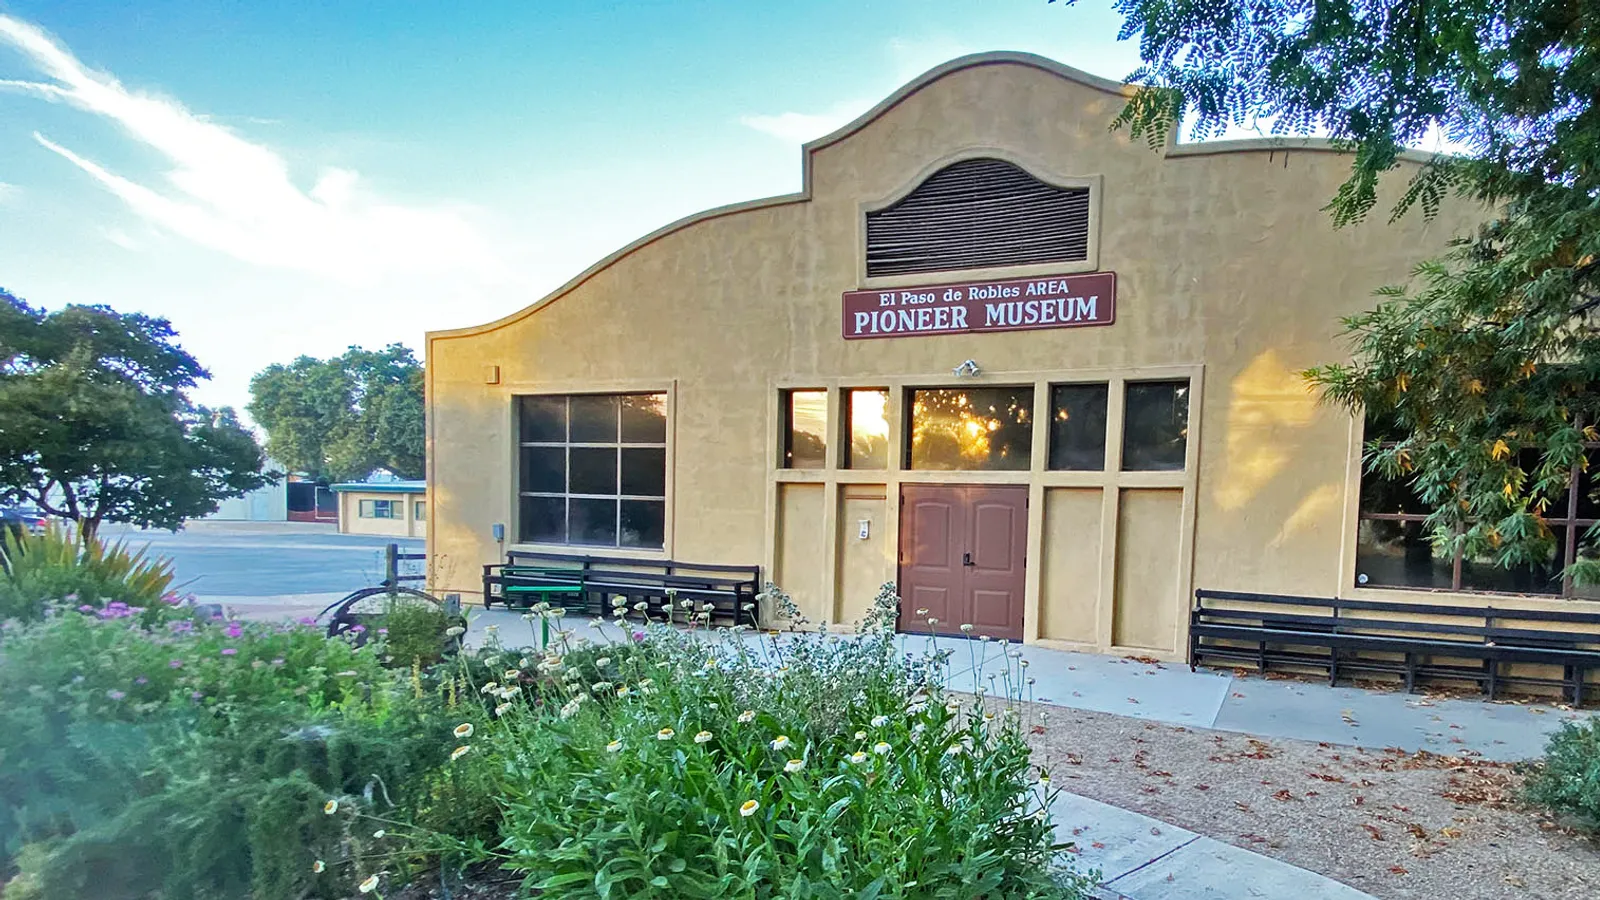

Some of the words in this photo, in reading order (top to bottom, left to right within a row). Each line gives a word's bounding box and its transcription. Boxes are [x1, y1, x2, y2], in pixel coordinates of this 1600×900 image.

[879, 293, 896, 307] El
[901, 291, 935, 306] Paso
[943, 288, 962, 301] de
[968, 285, 1020, 300] Robles
[1025, 280, 1069, 296] AREA
[854, 305, 968, 334] PIONEER
[984, 295, 1098, 327] MUSEUM
